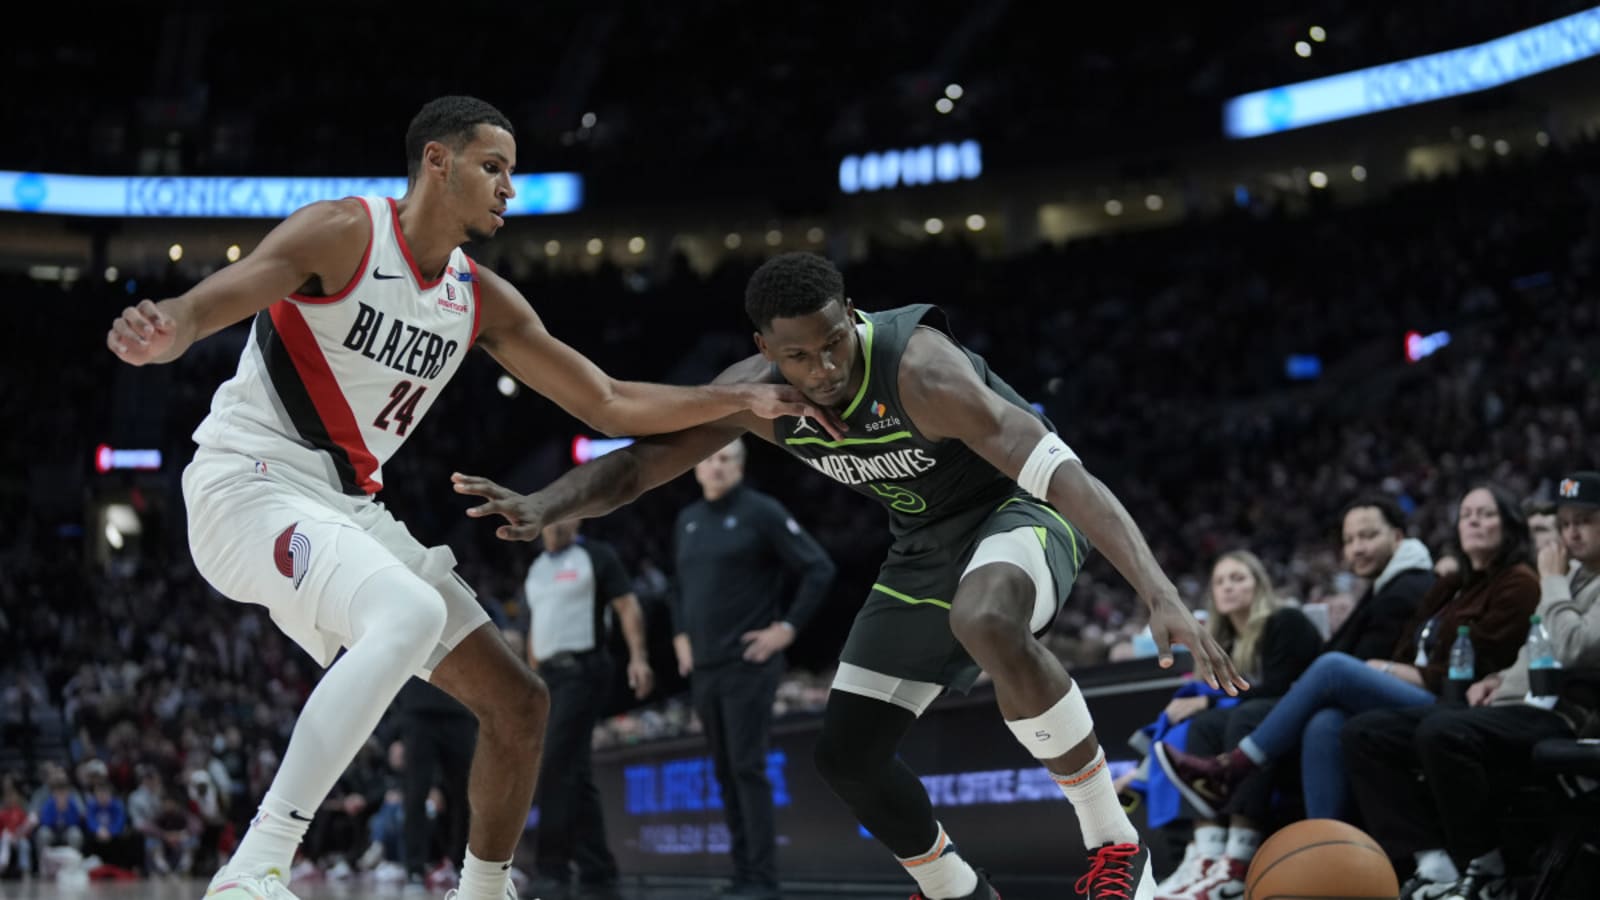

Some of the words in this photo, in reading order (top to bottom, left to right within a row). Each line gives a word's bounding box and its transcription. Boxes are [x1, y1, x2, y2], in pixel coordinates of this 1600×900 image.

[342, 301, 458, 380] BLAZERS
[373, 379, 428, 437] 24
[865, 416, 901, 432] sezzle
[808, 449, 936, 485] MBERWOLVES
[869, 483, 927, 513] 5
[1035, 730, 1051, 742] 5
